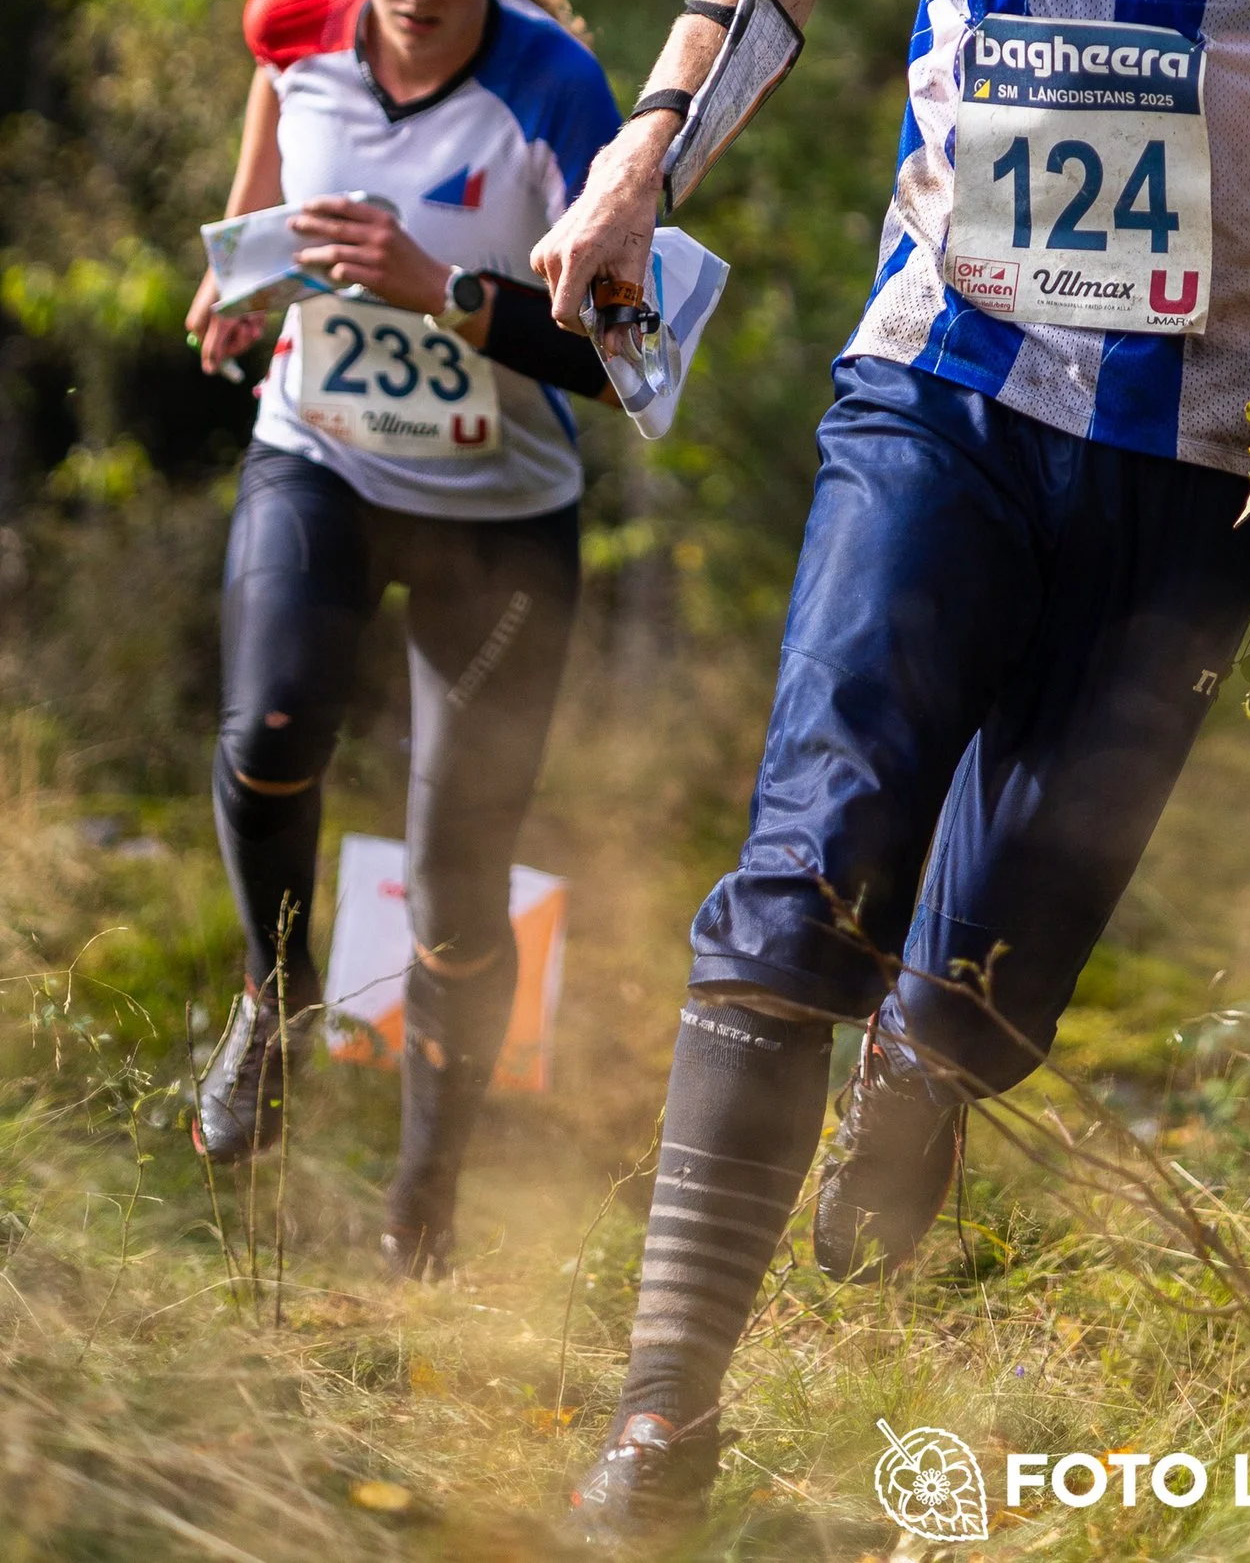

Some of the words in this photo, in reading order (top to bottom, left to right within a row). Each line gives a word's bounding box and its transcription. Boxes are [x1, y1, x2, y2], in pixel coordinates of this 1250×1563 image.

[974, 29, 1190, 79] bagheera
[997, 83, 1019, 100] SM
[1140, 92, 1175, 107] 2025
[993, 136, 1180, 254] 124
[957, 278, 1014, 296] Tisaren
[1033, 269, 1136, 299] Ullmax
[1149, 270, 1199, 314] U
[322, 315, 470, 403] 233
